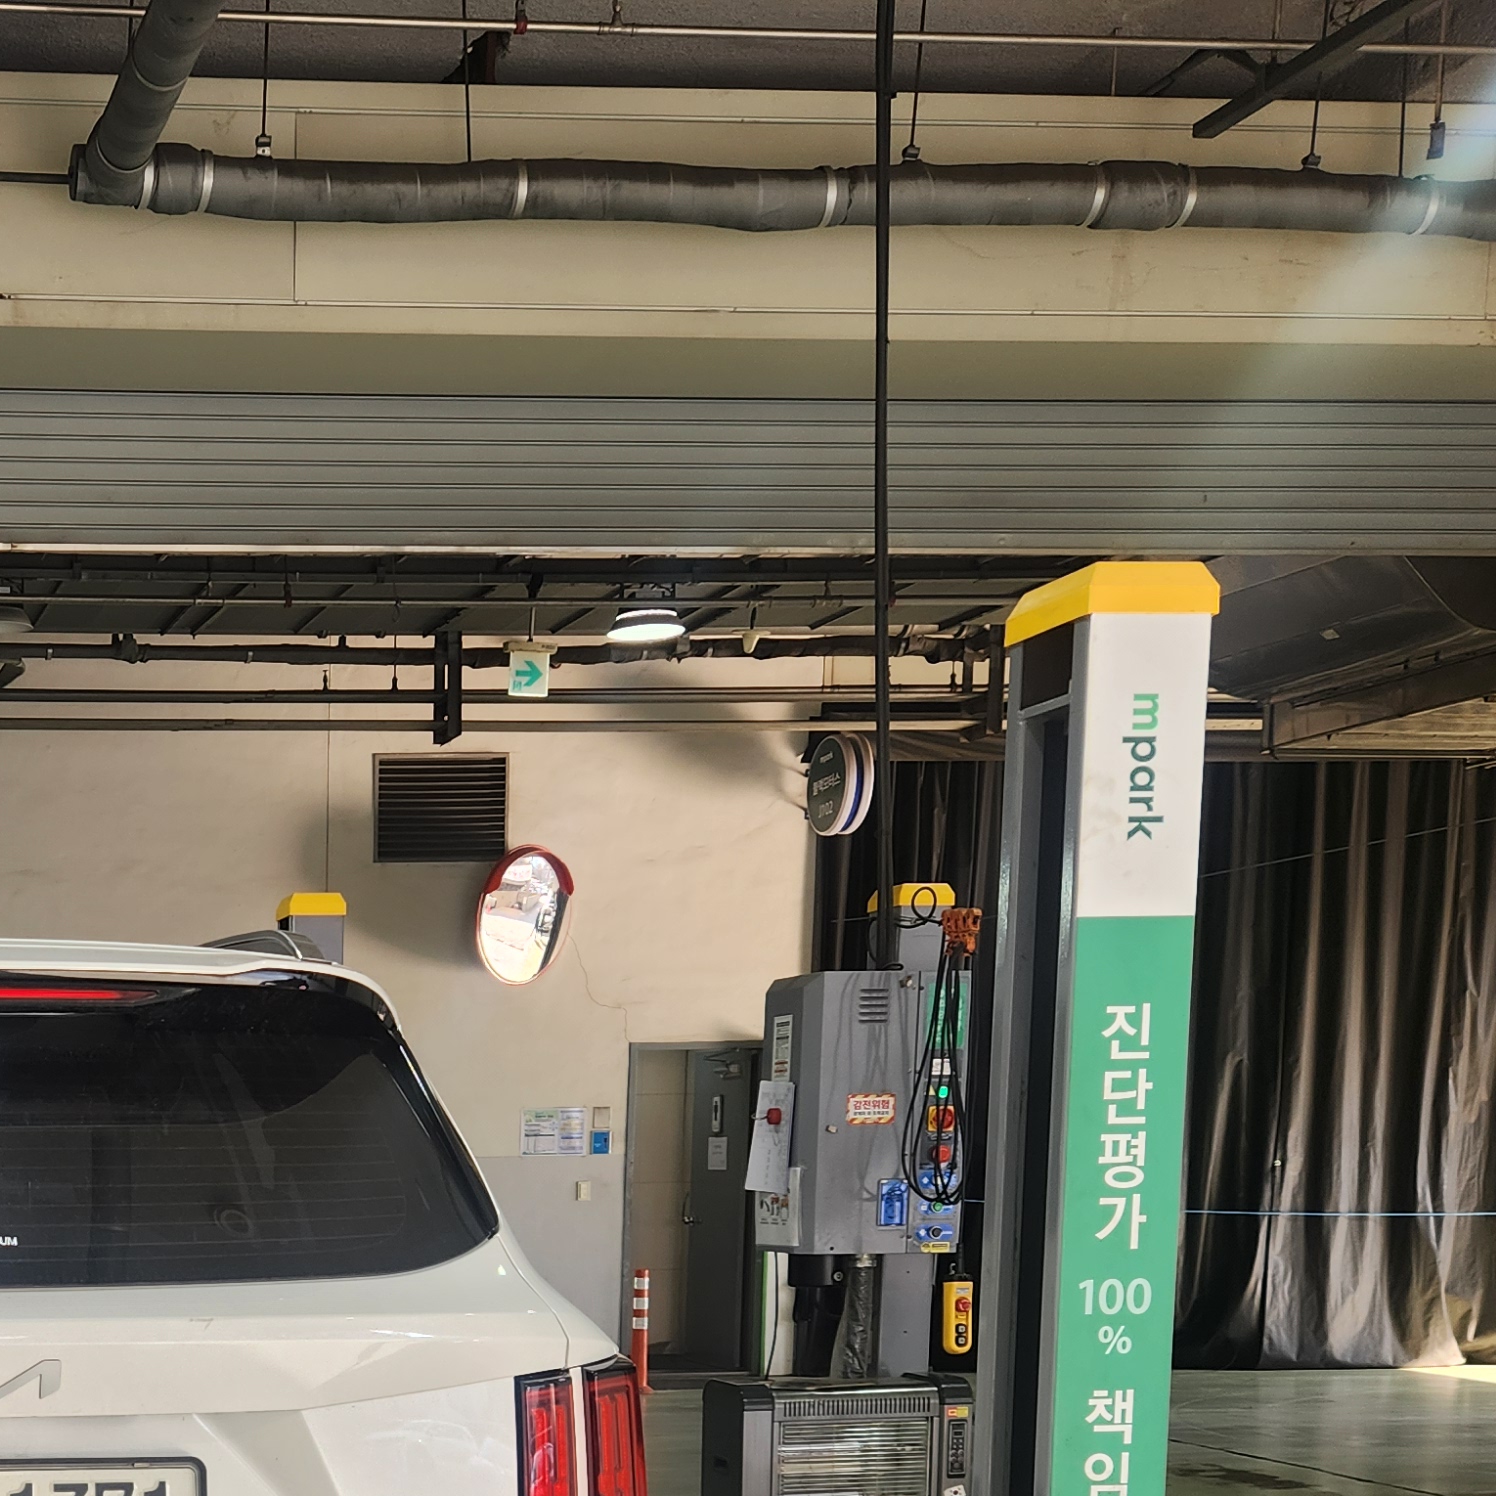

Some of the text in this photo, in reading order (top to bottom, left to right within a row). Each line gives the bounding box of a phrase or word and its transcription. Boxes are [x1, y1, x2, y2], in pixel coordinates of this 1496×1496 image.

[1122, 693, 1164, 841] mpark
[1095, 1002, 1154, 1250] 진단평가
[1078, 1277, 1153, 1315] 100
[1098, 1324, 1133, 1355] %
